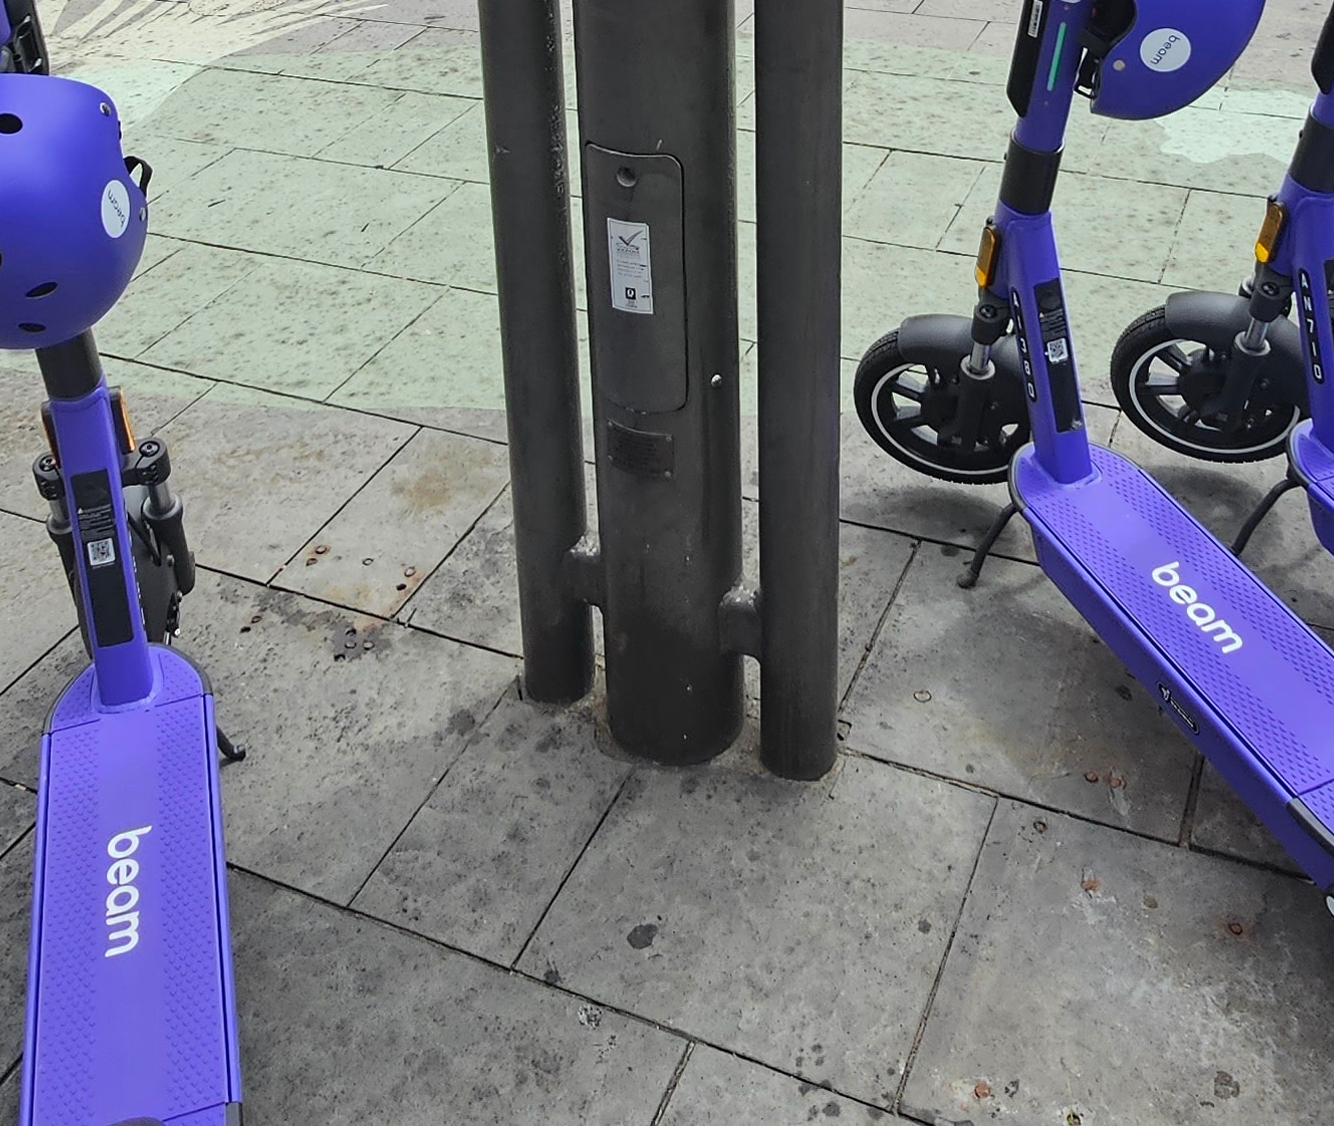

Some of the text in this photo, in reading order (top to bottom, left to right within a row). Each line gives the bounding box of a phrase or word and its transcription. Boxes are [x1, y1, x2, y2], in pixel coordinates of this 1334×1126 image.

[1150, 34, 1181, 65] beam
[1152, 561, 1243, 654] beam
[104, 825, 153, 958] beam
